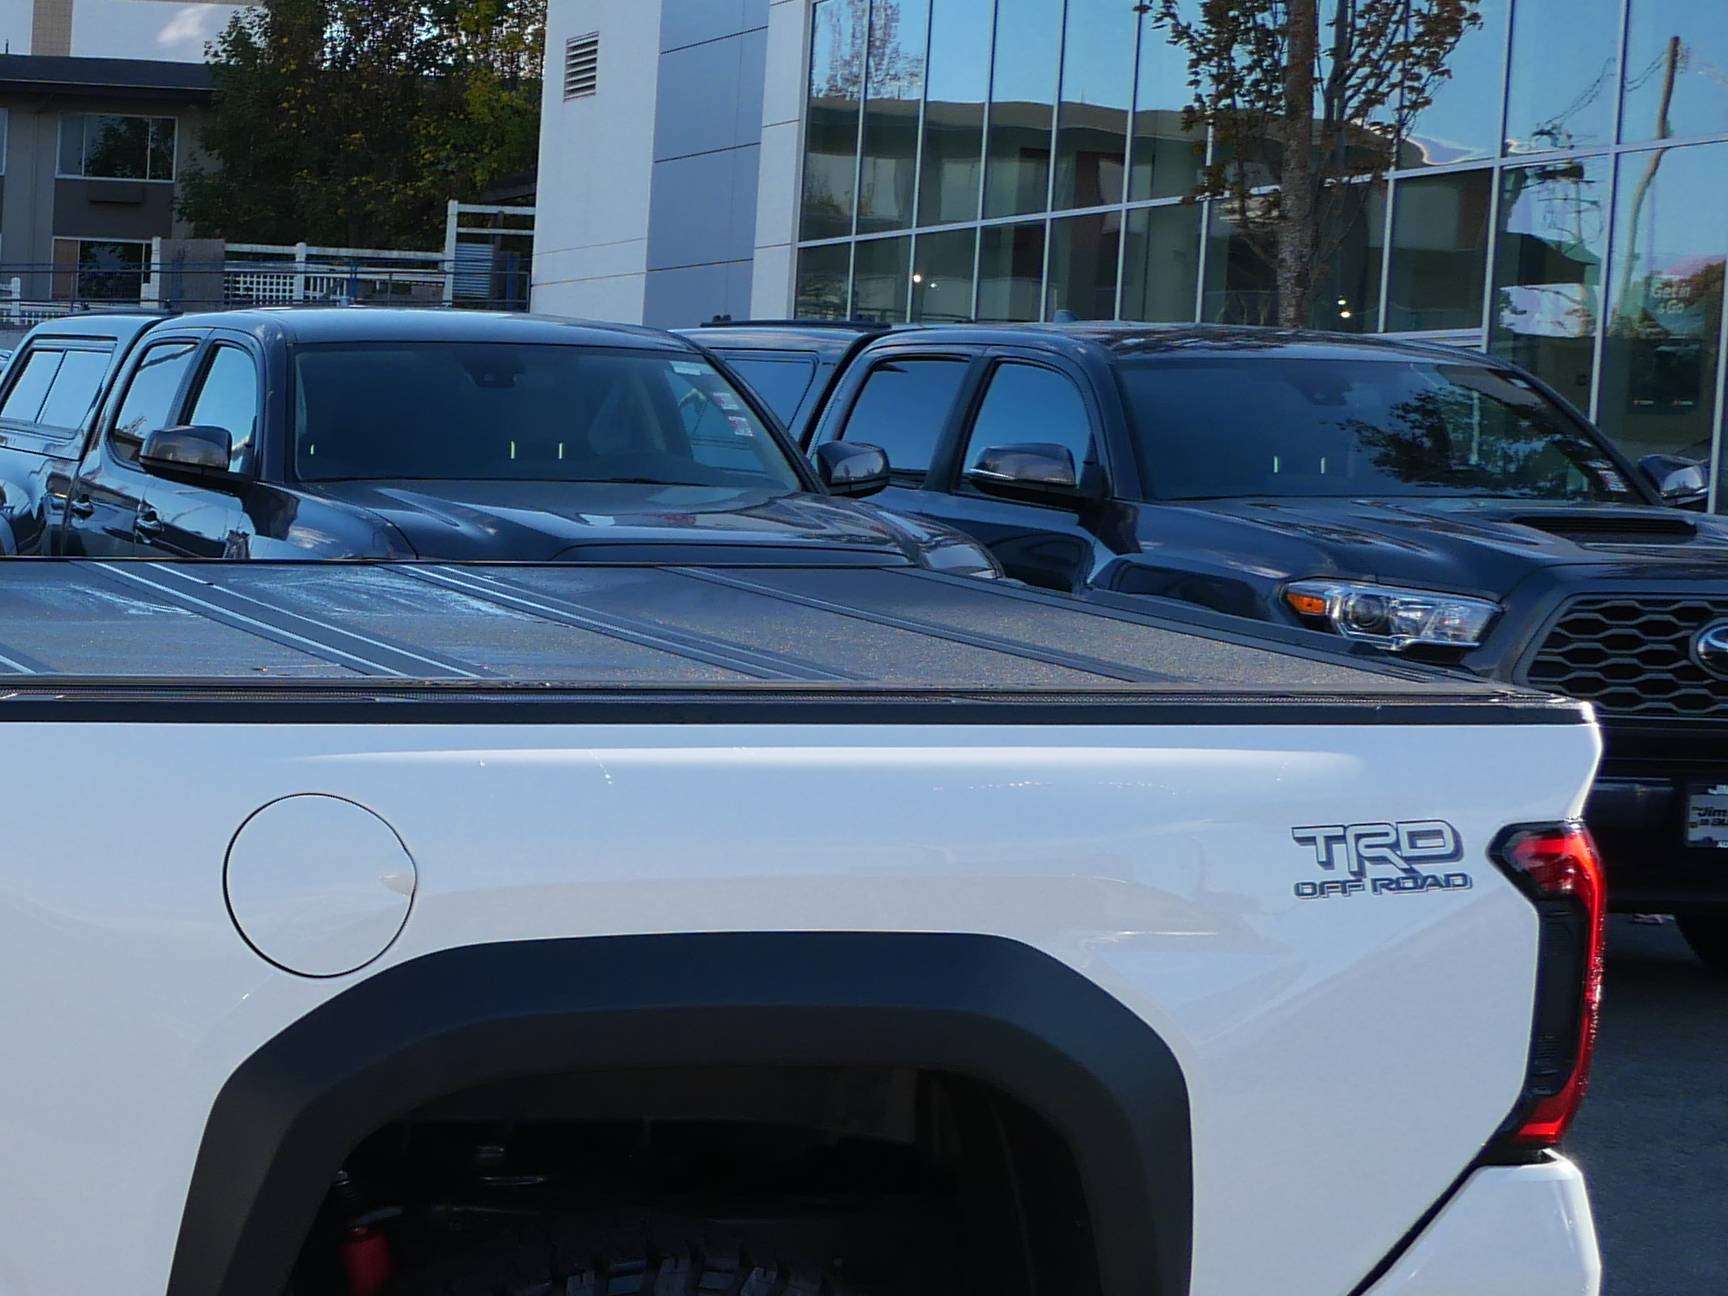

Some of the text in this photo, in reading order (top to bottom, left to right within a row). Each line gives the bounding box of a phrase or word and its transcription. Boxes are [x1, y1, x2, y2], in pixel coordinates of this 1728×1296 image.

[1291, 819, 1463, 878] TRD
[1294, 872, 1473, 900] OFF ROAD
